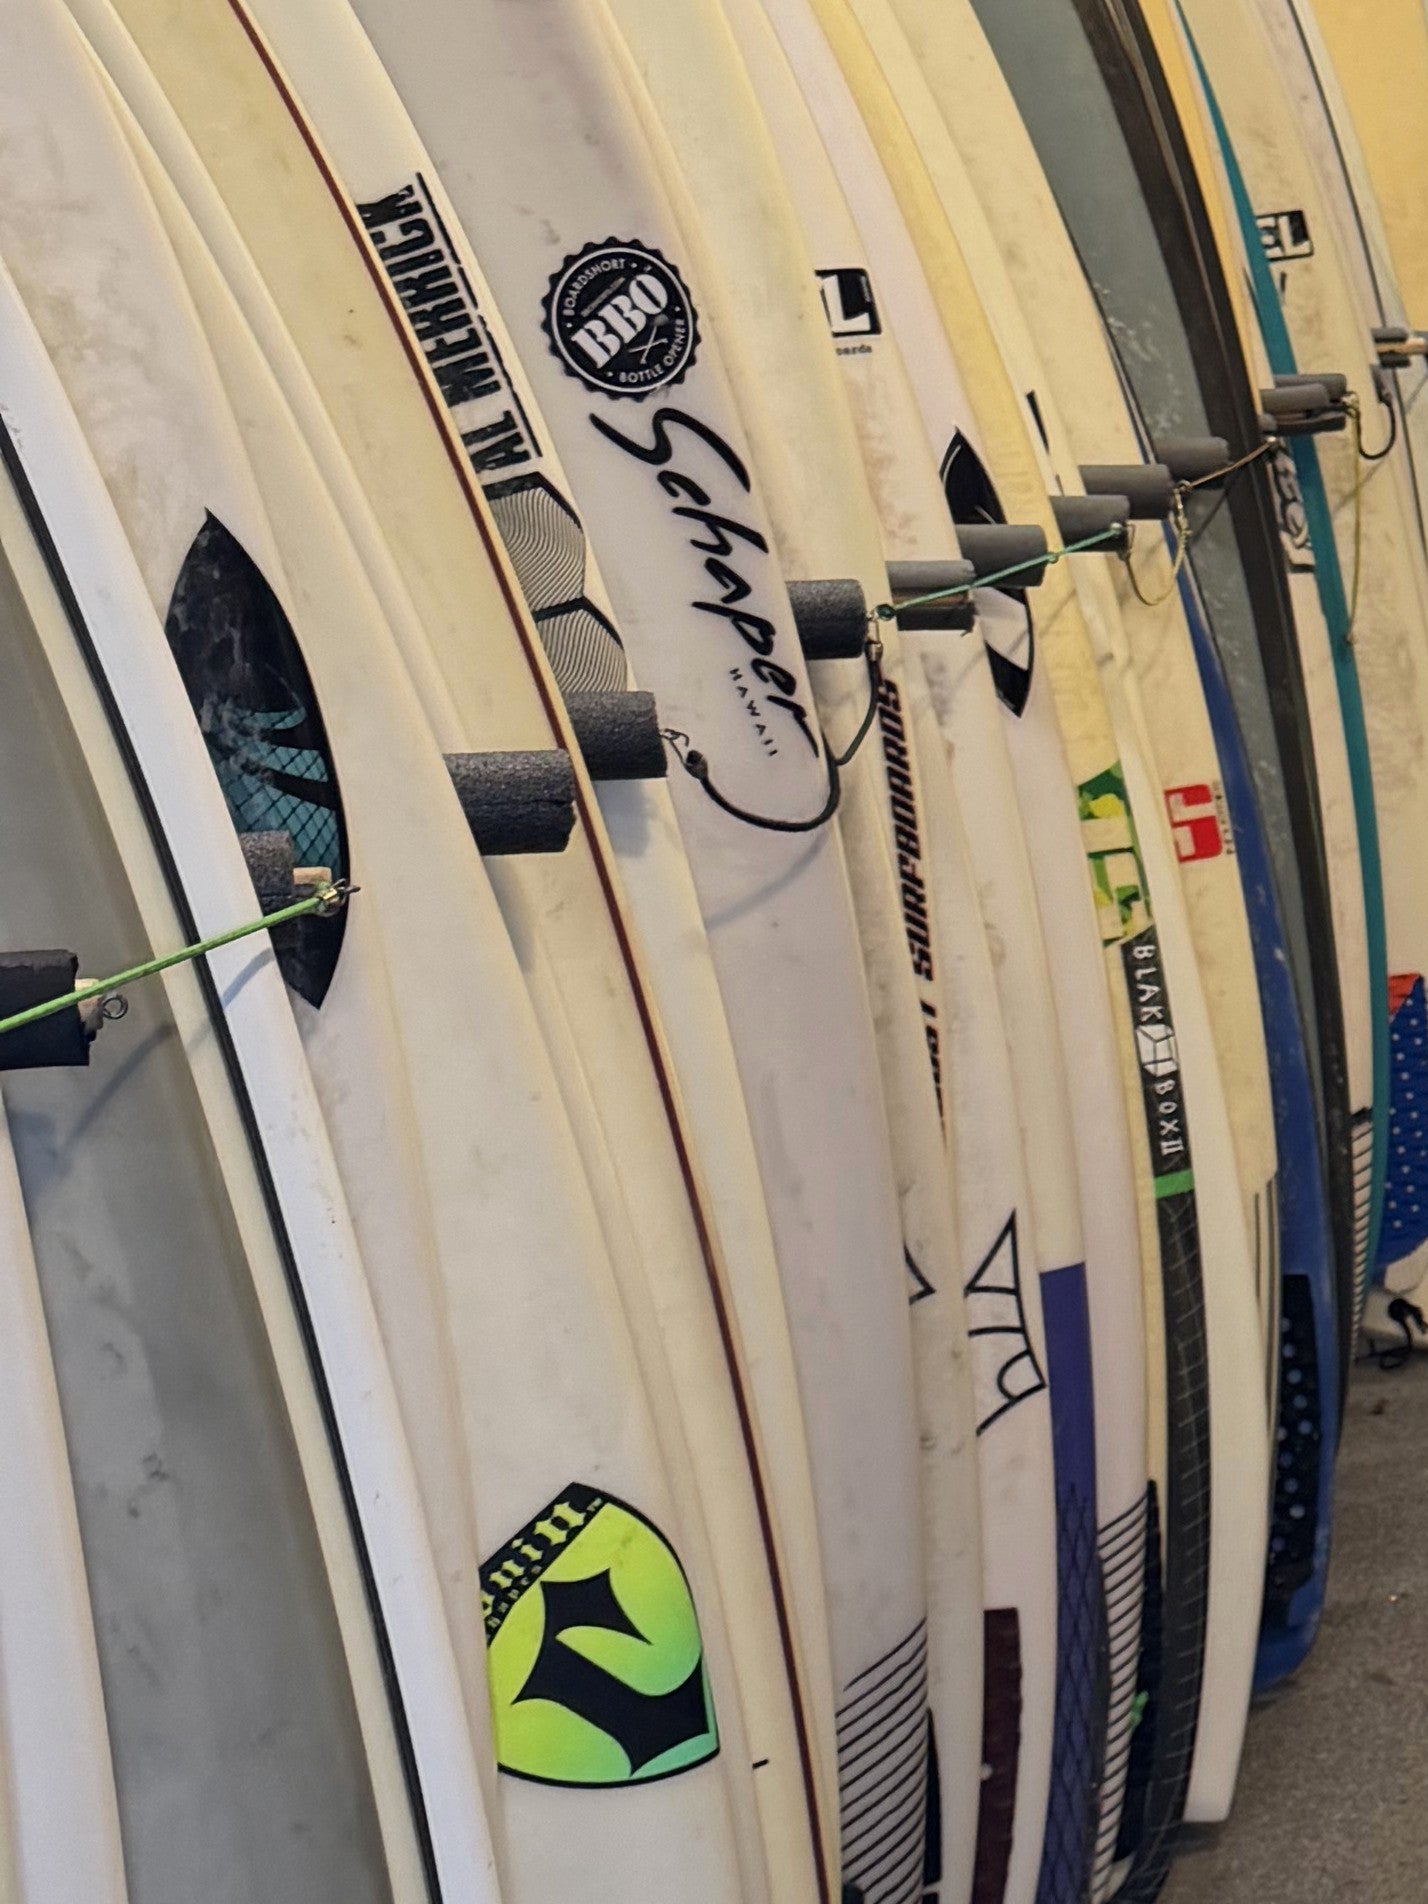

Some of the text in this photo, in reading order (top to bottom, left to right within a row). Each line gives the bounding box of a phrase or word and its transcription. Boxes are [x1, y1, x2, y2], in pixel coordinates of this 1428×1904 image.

[562, 258, 626, 316] BOARDSHORT
[570, 273, 669, 370] BBO
[619, 364, 663, 383] BOTTLE
[589, 407, 821, 759] Schaper
[729, 667, 779, 758] HAWAII
